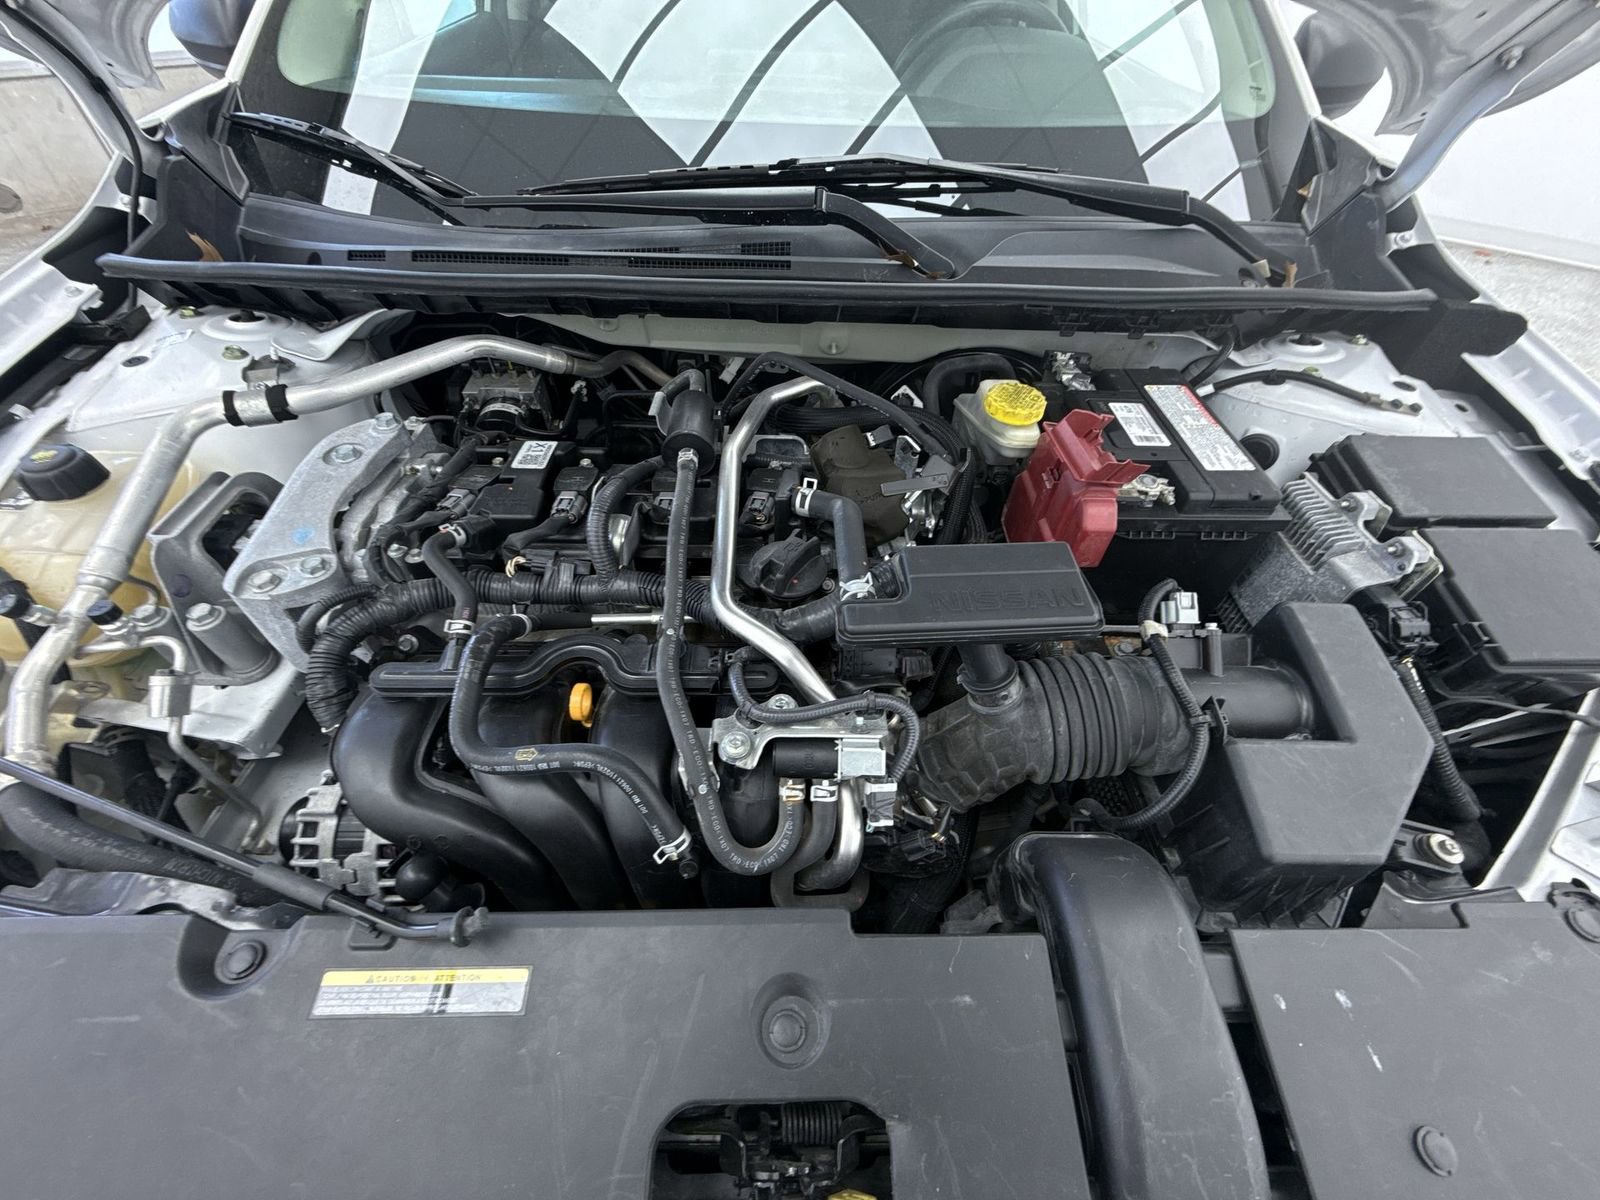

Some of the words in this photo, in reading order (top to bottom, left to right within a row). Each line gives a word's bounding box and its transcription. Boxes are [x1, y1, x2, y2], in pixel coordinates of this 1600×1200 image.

[932, 587, 1086, 611] NISSAN
[376, 975, 416, 983] CAUTION
[434, 974, 481, 982] ATTENTION
